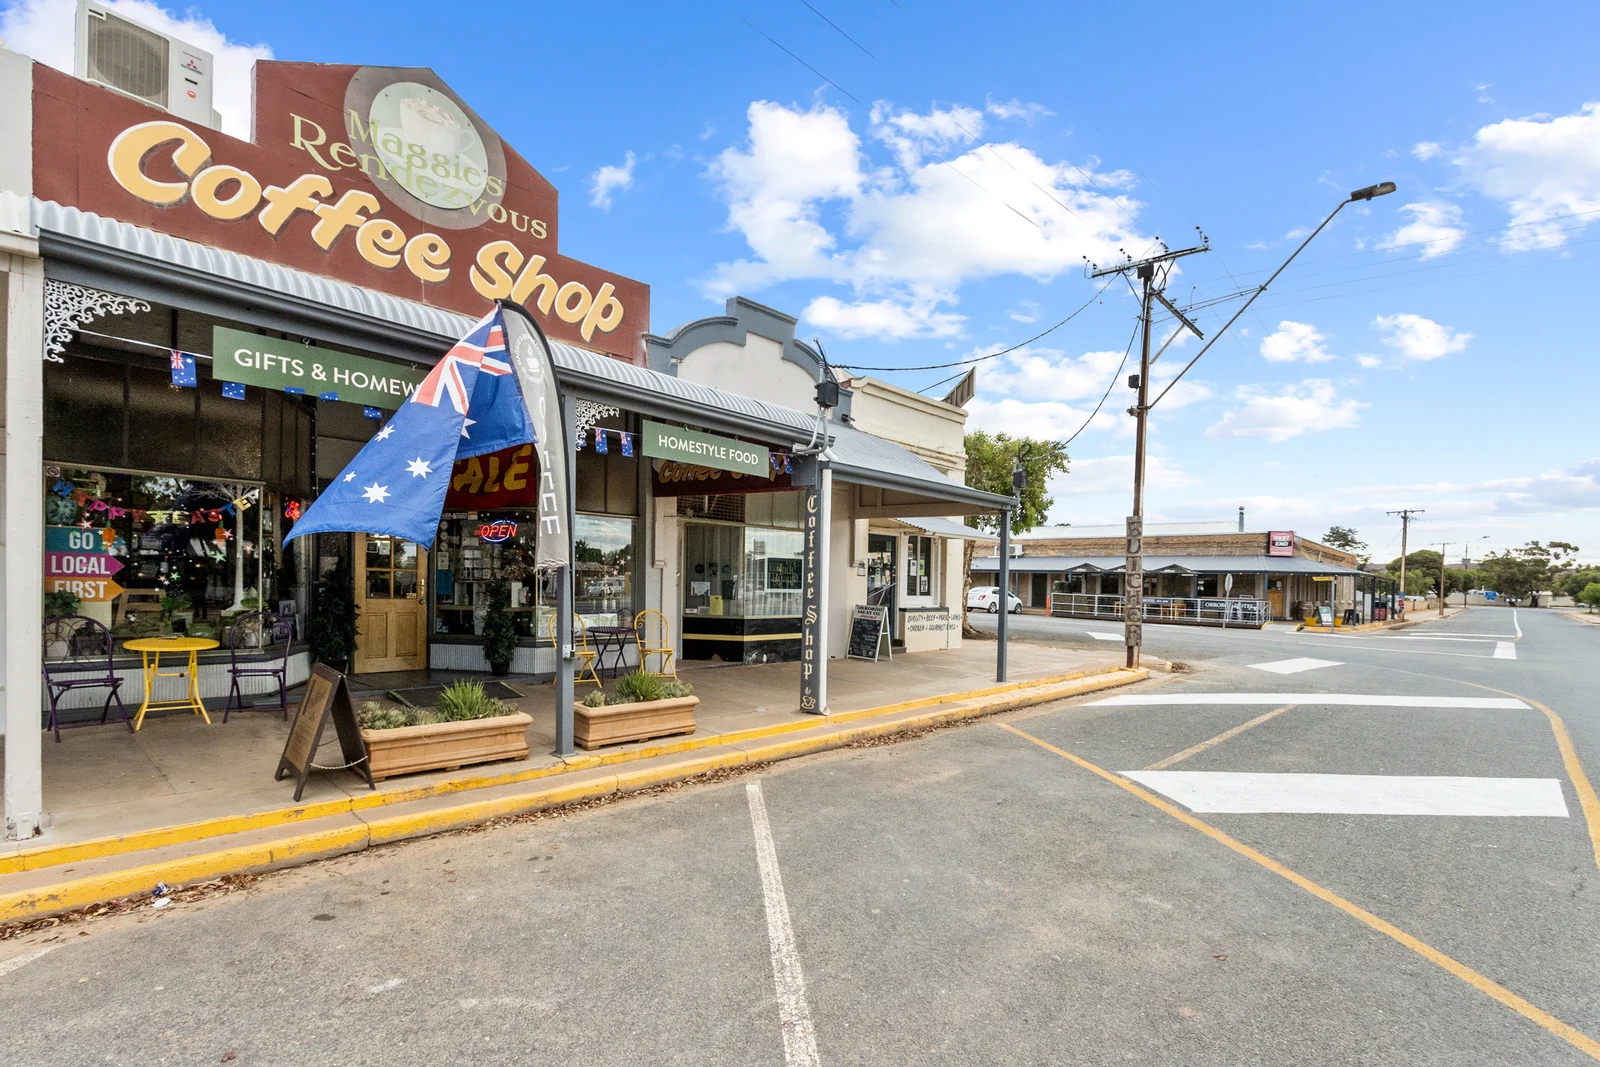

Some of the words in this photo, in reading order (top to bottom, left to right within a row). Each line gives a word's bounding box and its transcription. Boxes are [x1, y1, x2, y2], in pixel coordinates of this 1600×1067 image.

[289, 112, 548, 239] Rendezvous
[107, 121, 452, 284] Coffee
[470, 240, 625, 343] Shop
[233, 348, 304, 377] GIFTS
[311, 363, 327, 382] &
[658, 434, 726, 459] HOMESTYLE
[729, 449, 759, 465] FOOD
[449, 443, 533, 494] ALE
[69, 531, 94, 550] GO
[481, 524, 518, 537] OPEN
[806, 494, 818, 600] Coffee
[51, 555, 111, 575] LOCAL
[54, 580, 108, 599] FIRST
[804, 604, 818, 680] Shop
